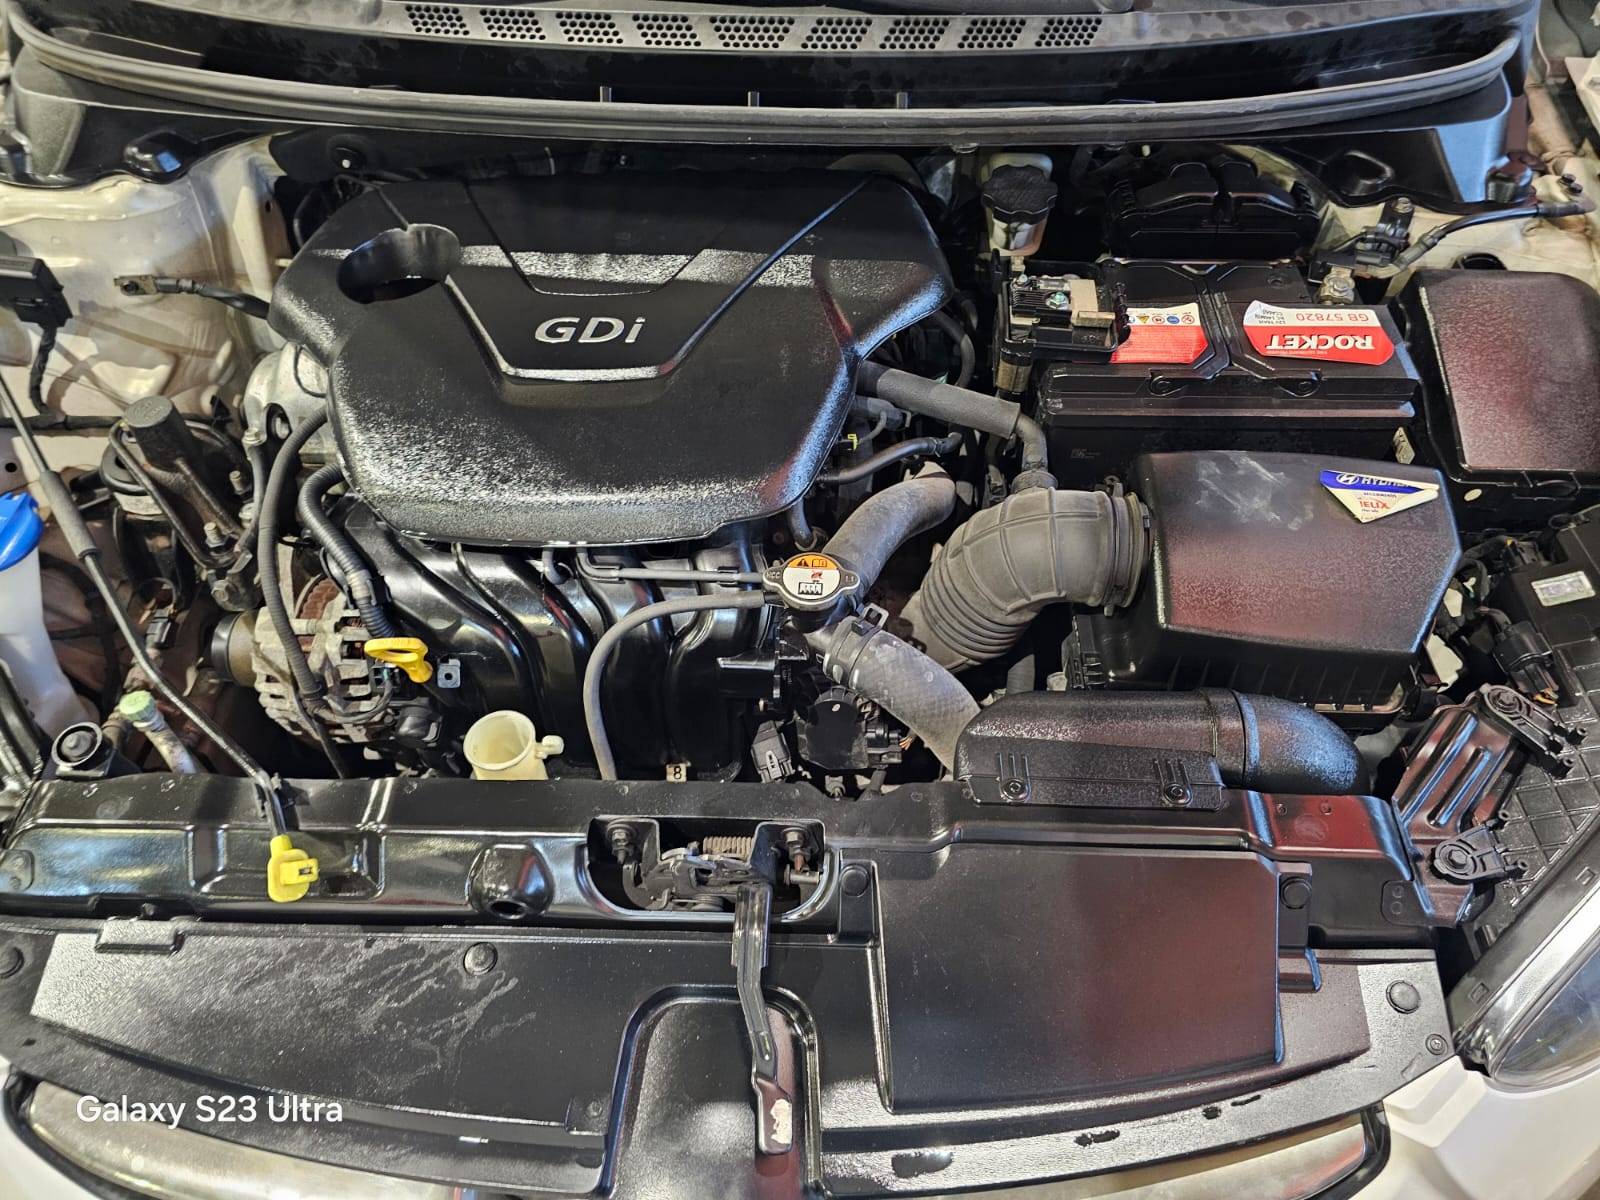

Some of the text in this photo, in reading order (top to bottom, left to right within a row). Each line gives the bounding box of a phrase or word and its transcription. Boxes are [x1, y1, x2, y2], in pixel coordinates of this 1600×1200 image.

[1296, 313, 1369, 322] GB 57820
[535, 317, 646, 343] GDi
[1265, 334, 1376, 350] ROCKET
